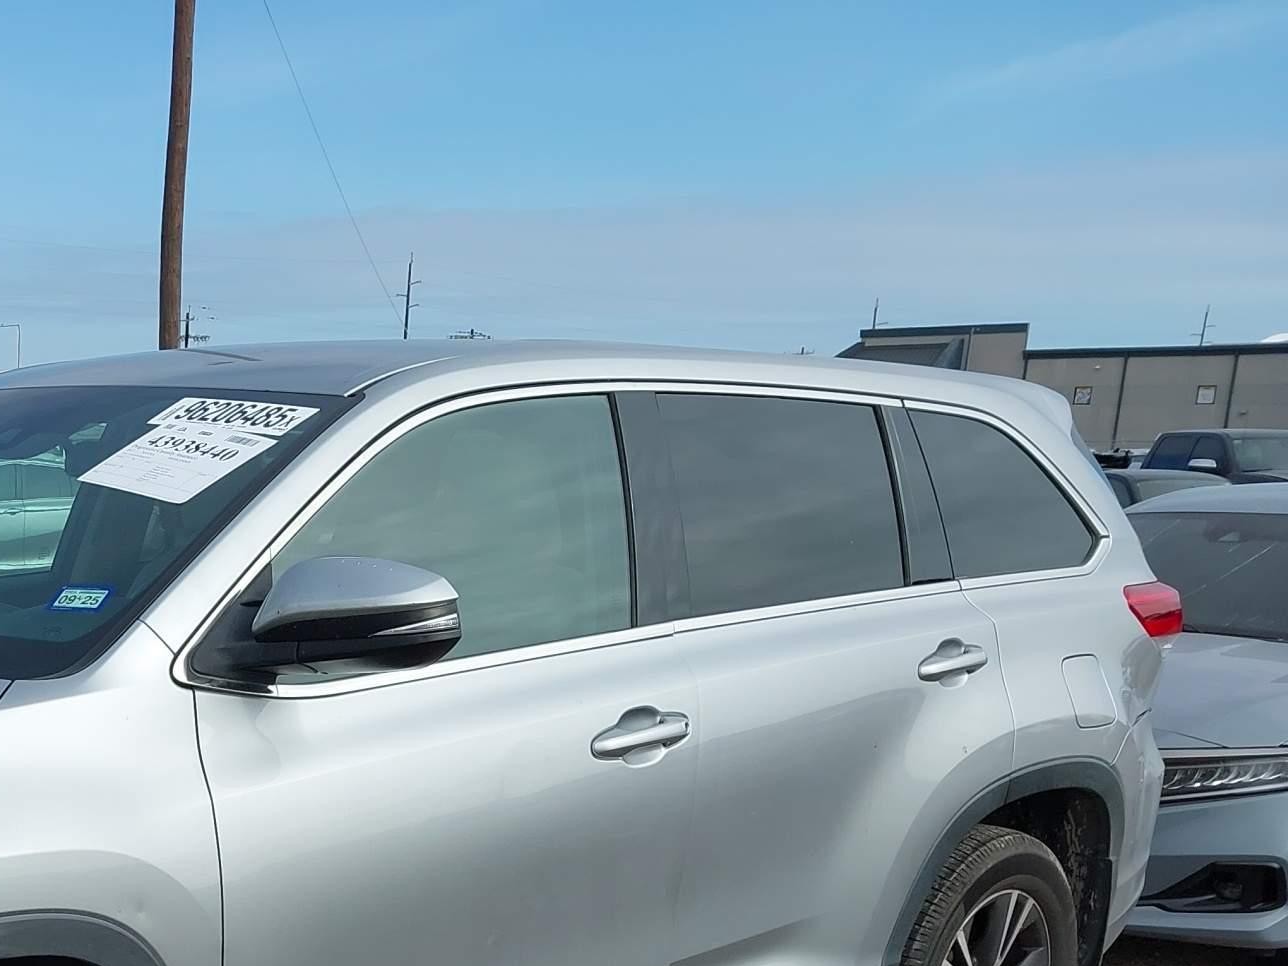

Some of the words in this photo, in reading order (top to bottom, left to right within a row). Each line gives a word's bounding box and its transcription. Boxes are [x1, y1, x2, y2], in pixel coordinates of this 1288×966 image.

[174, 400, 298, 428] 96206485
[147, 434, 240, 462] 43938440
[80, 595, 102, 606] 25
